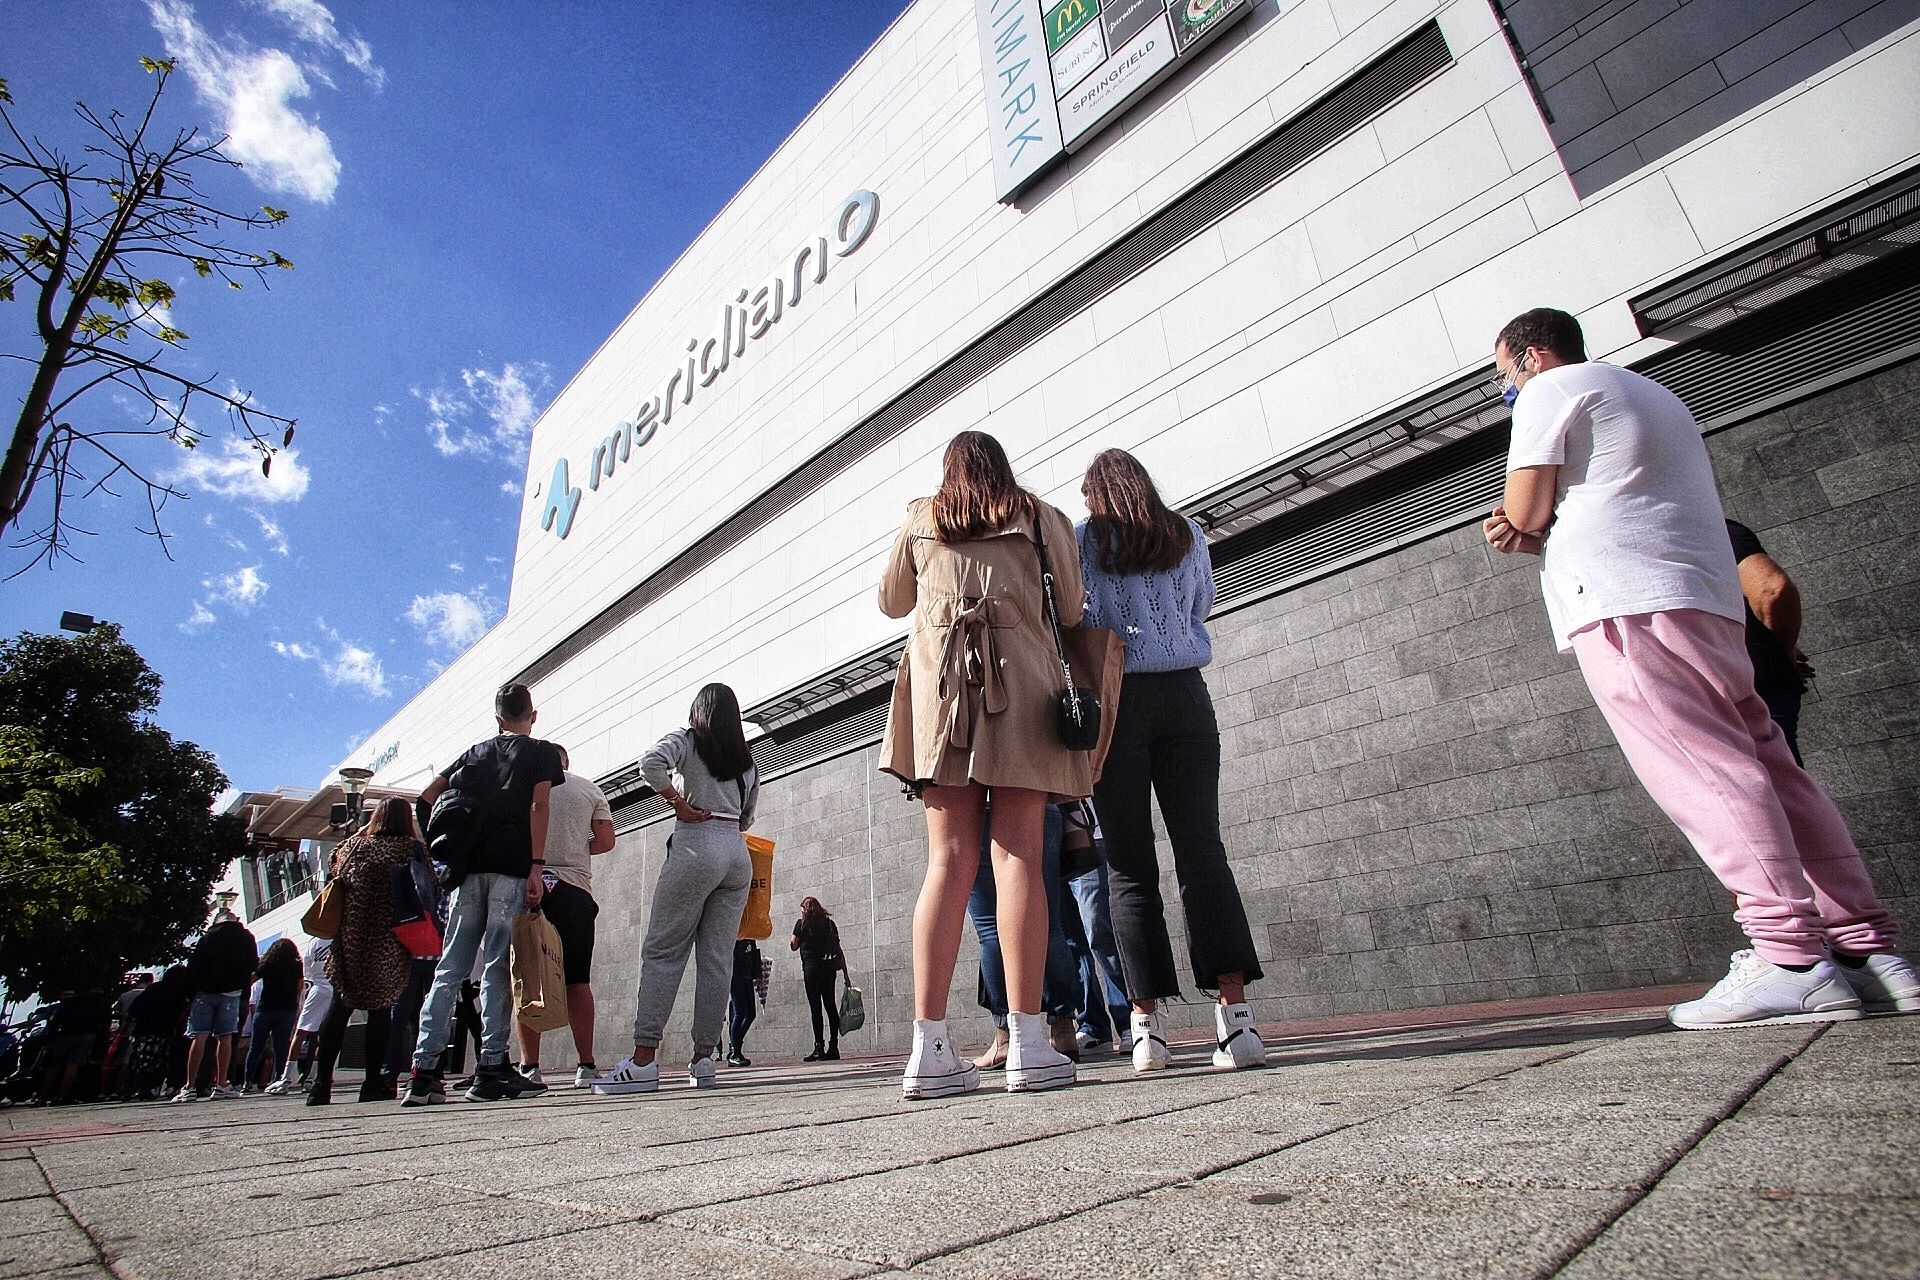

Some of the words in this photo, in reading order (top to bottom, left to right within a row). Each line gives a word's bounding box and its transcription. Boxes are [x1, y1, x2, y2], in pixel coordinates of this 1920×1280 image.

[1183, 32, 1195, 44] LA
[990, 0, 1044, 169] IMARK
[1072, 40, 1155, 114] SPRINGFIELD
[589, 188, 881, 492] meridiano
[1138, 1020, 1151, 1028] NIKE
[1234, 1010, 1249, 1019] NIKE
